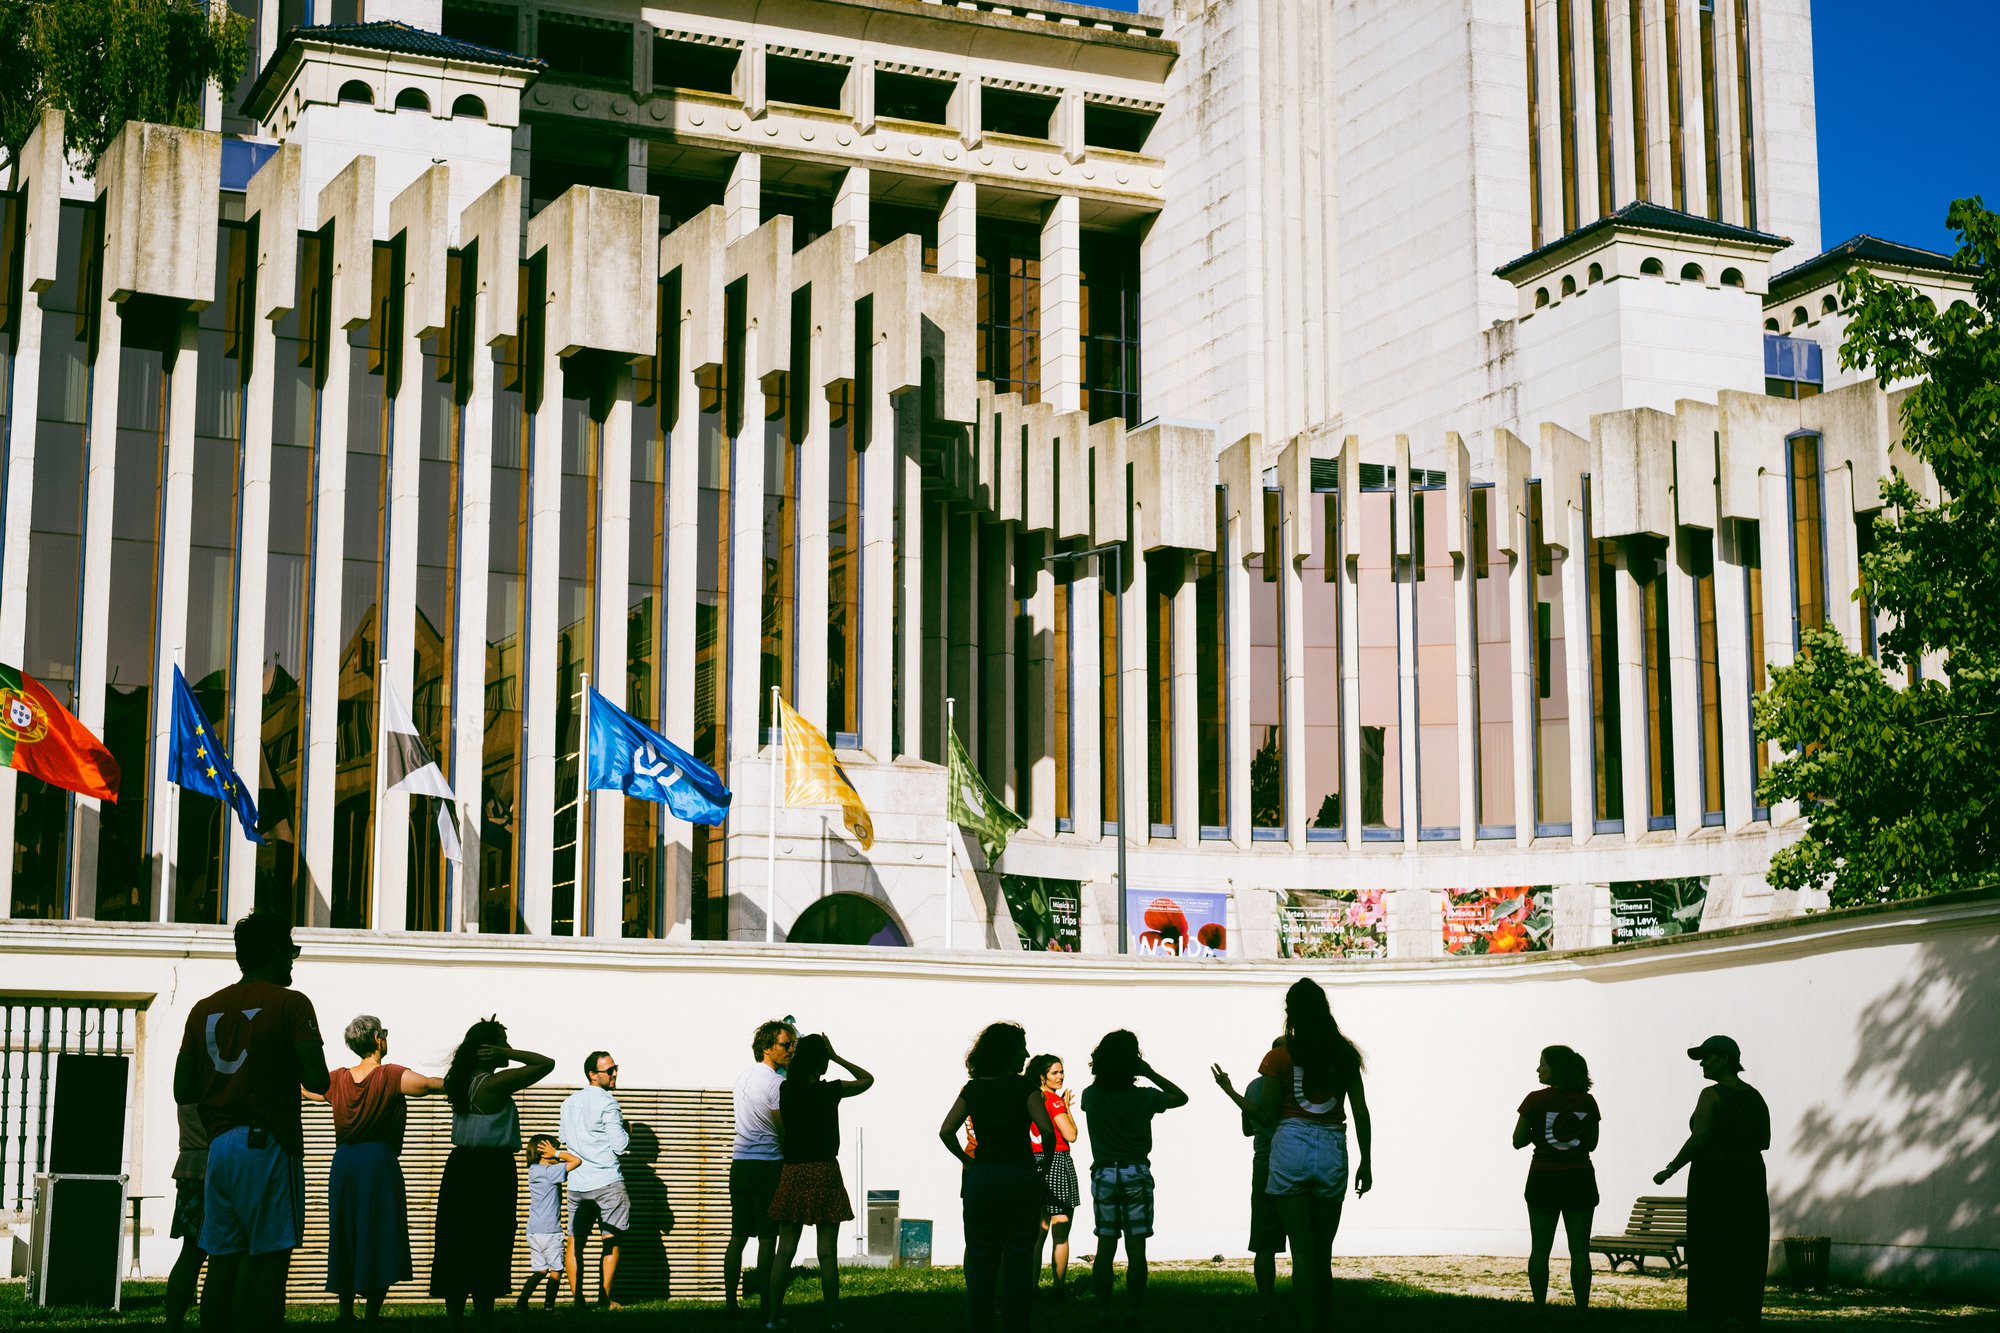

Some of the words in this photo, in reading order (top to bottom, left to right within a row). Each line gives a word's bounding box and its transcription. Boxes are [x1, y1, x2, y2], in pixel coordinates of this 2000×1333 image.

[1619, 903, 1643, 911] Cinema
[1286, 910, 1304, 918] Artes
[1451, 908, 1476, 917] Música
[1052, 915, 1061, 924] Tó
[1062, 915, 1077, 926] Trips
[1617, 917, 1635, 926] Eliza
[1637, 916, 1659, 926] Levy,
[1283, 923, 1307, 933] Sónia
[1310, 924, 1345, 933] Almeida
[1448, 923, 1465, 932] Tim
[1468, 923, 1499, 932] Hecker
[1617, 928, 1634, 937] Rita
[1635, 926, 1665, 936] Natálio
